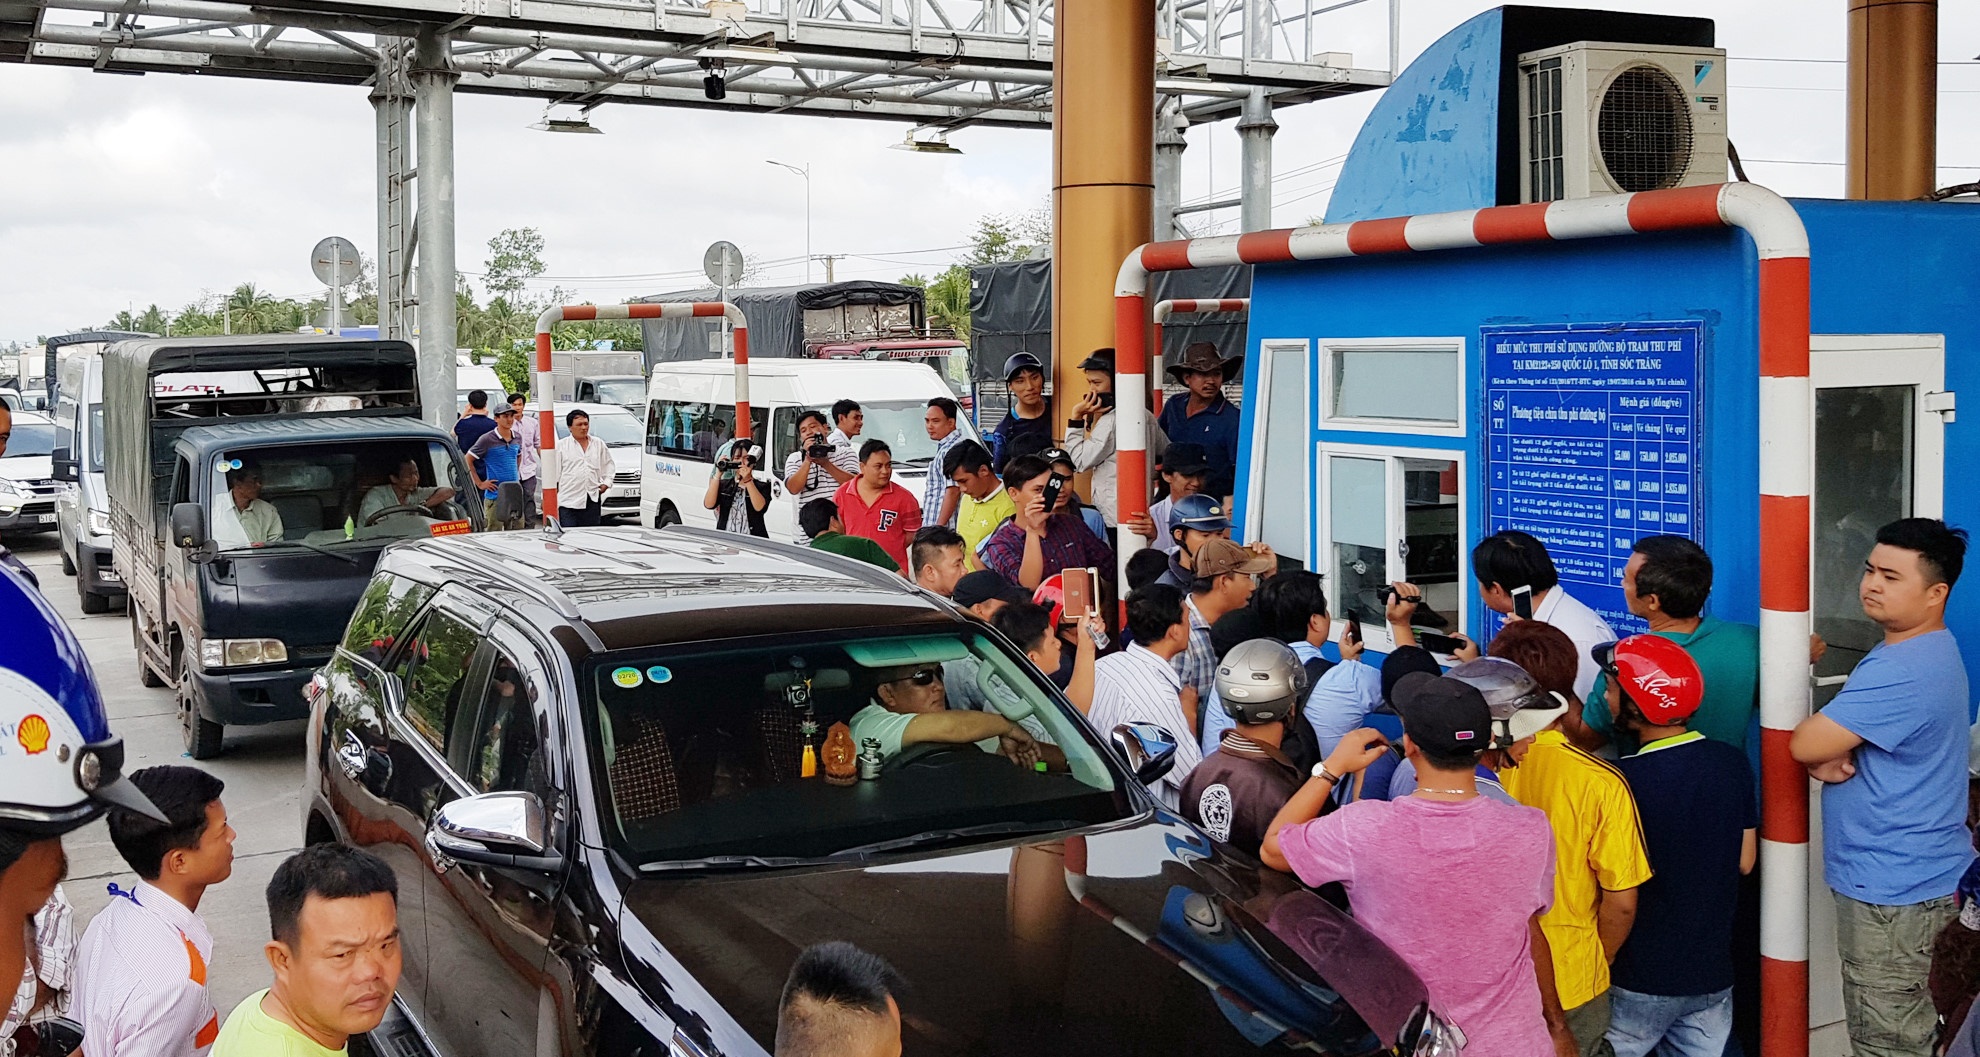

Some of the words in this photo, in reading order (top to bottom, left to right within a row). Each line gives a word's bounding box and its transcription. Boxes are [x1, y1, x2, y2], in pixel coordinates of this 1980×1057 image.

[1512, 360, 1524, 372] TẠI
[1562, 355, 1582, 372] QUỐC
[1583, 357, 1592, 372] LỘ
[1600, 355, 1618, 369] TỈNH
[1620, 356, 1634, 370] SÓC
[1636, 356, 1661, 370] TRĂNG
[1493, 395, 1504, 410] SỐ
[1493, 418, 1504, 428] TT
[878, 508, 898, 531] F
